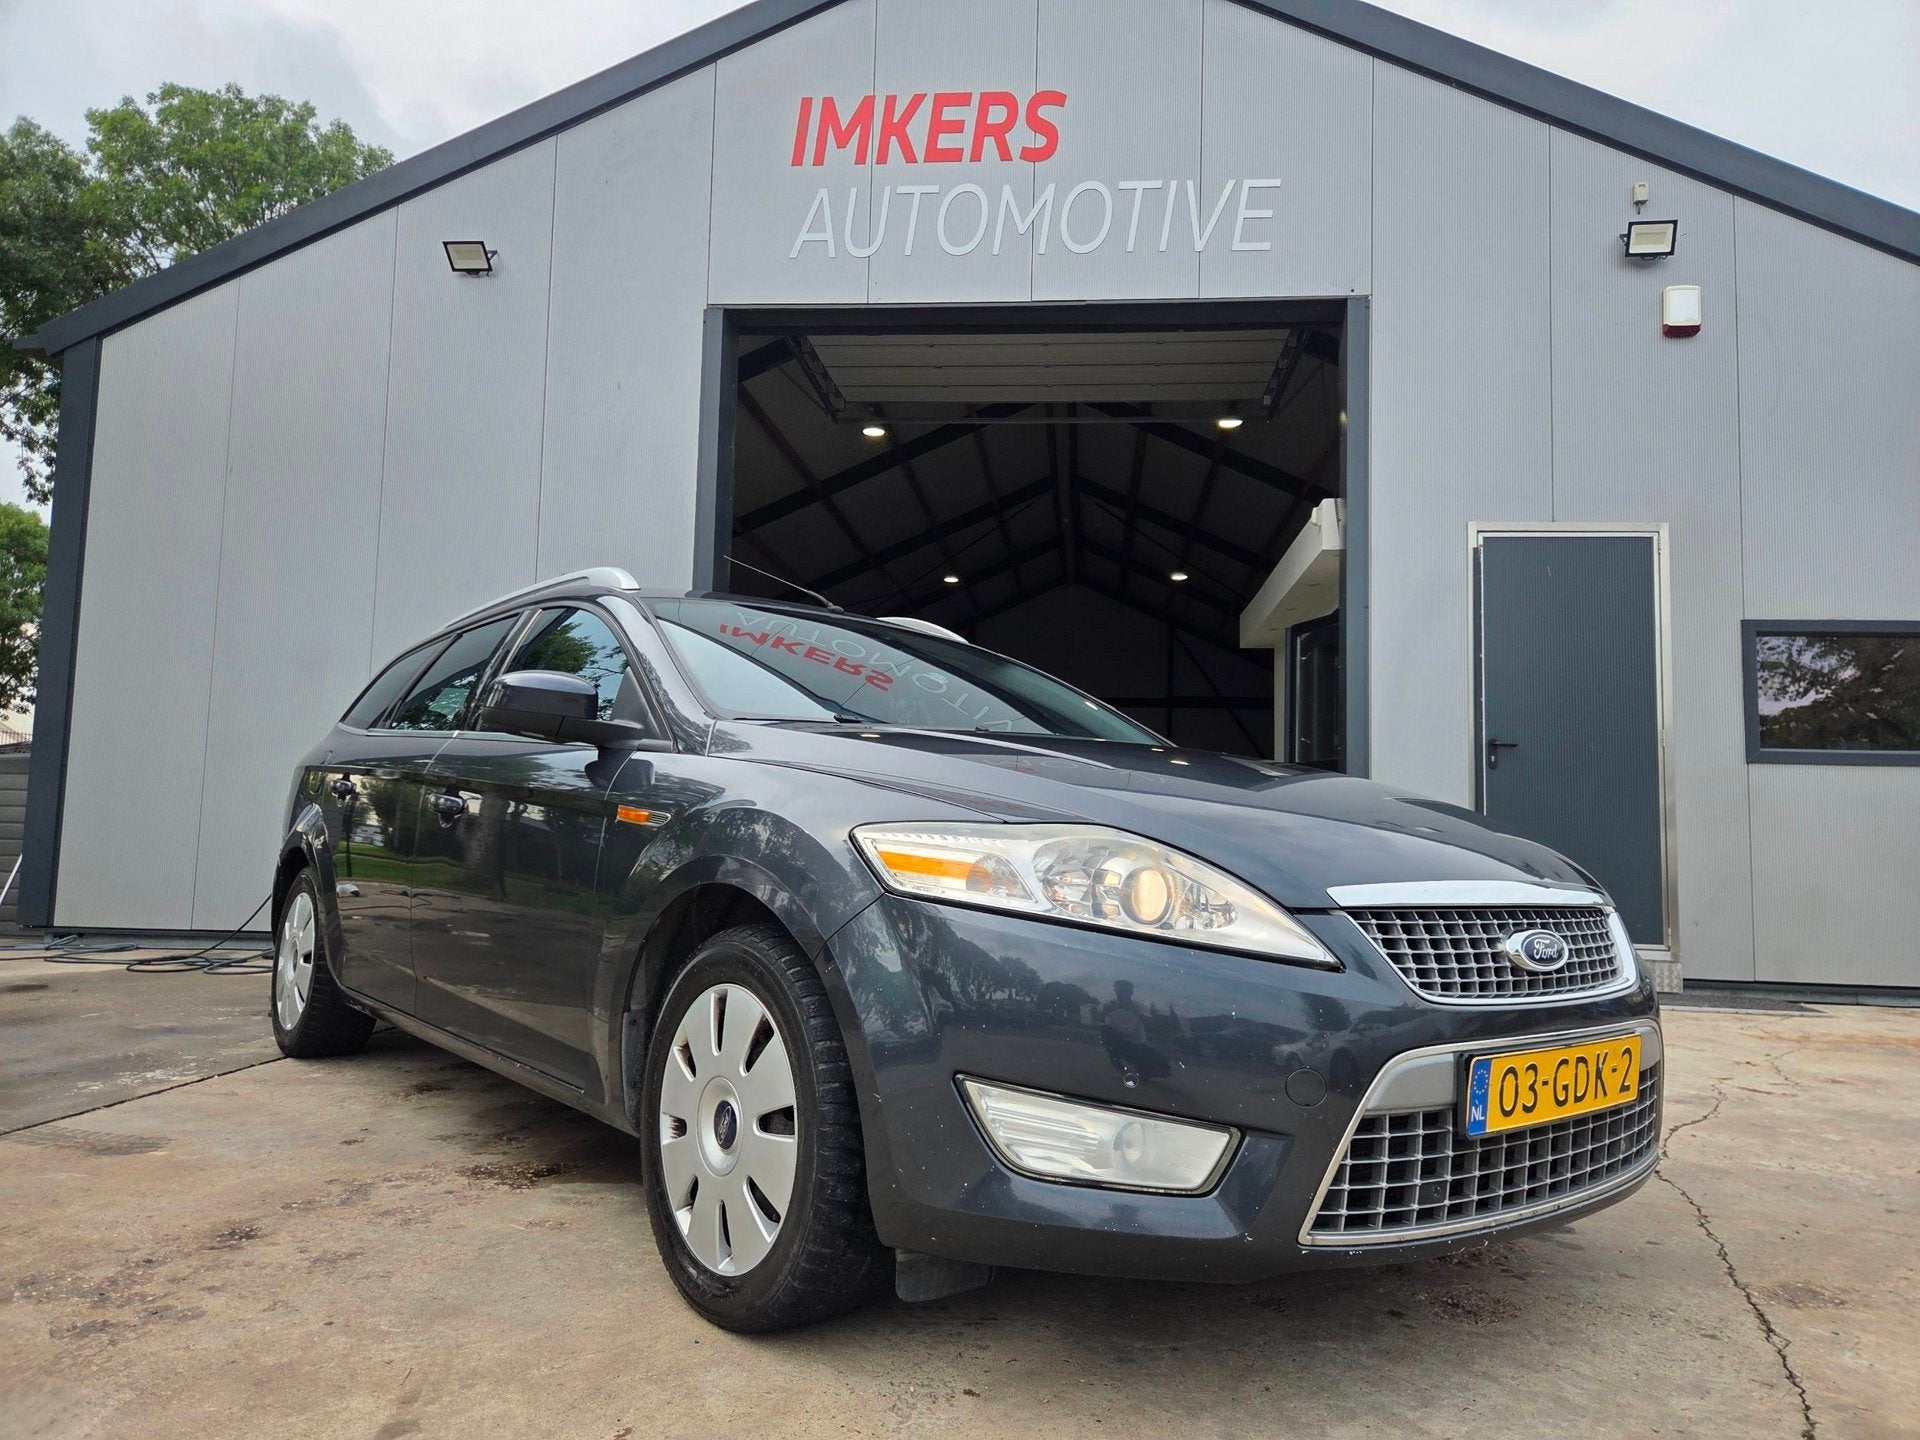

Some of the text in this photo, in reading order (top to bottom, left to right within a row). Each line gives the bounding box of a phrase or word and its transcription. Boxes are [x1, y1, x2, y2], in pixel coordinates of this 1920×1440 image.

[791, 90, 1067, 166] IMKERS
[788, 178, 1281, 259] AUTOMOTIVE
[1533, 938, 1558, 960] Ford
[1470, 1104, 1485, 1121] NL
[1499, 1047, 1633, 1118] 03-GDK-2
